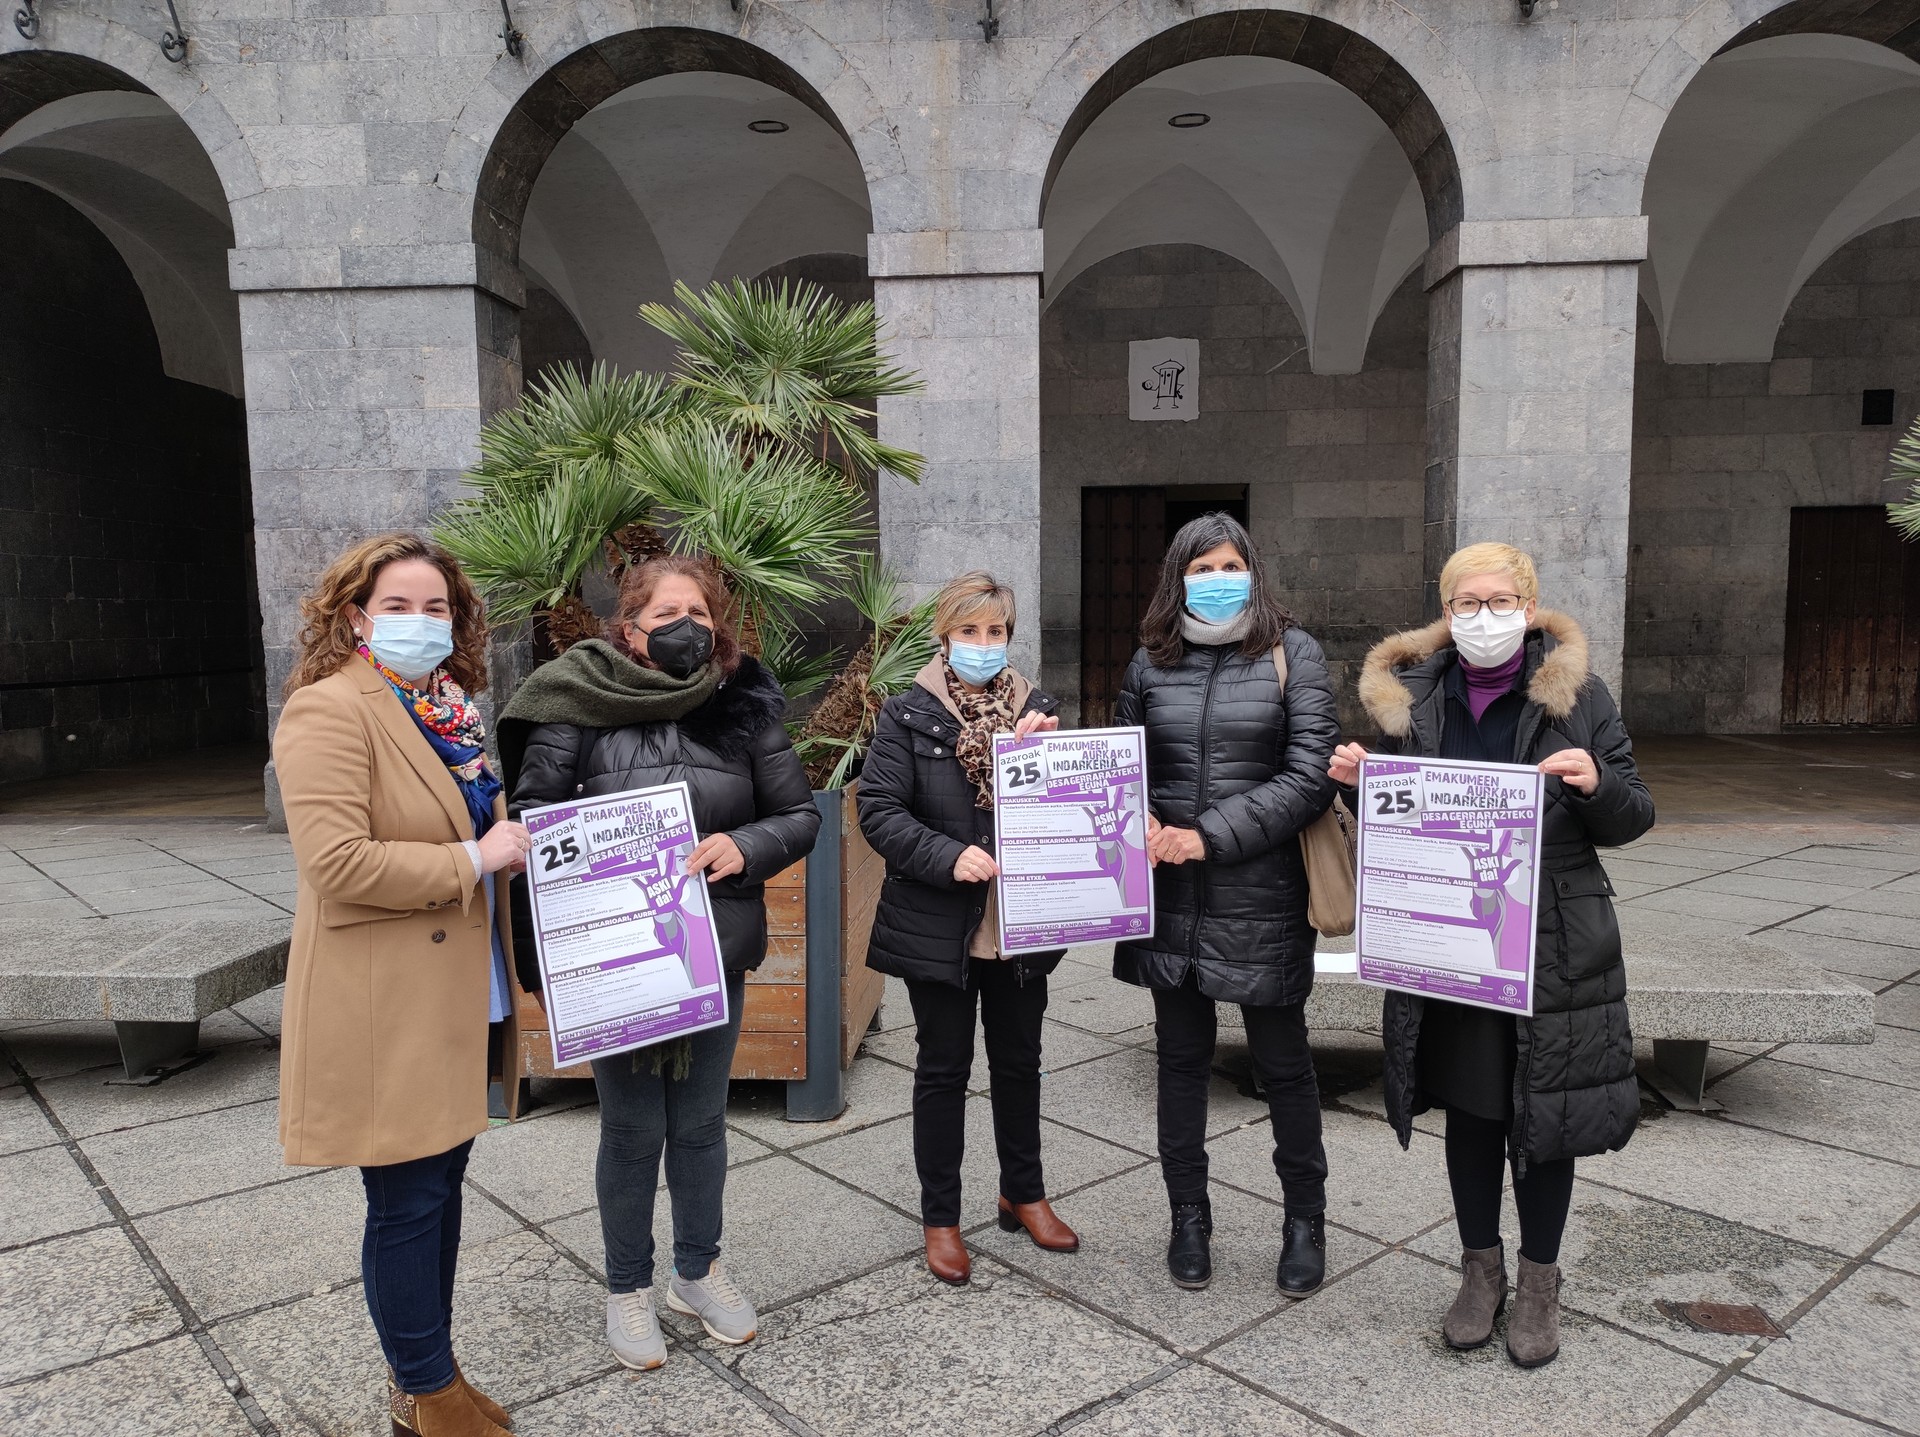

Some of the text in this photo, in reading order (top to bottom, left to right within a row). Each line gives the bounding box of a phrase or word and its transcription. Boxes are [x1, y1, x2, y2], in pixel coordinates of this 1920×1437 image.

[1047, 739, 1108, 752] EMAKUMEEN
[1082, 748, 1131, 759] AURKAKO
[1000, 749, 1040, 765] azaroak
[1053, 758, 1117, 771] INDARKERIA
[1005, 761, 1040, 788] 25
[1047, 766, 1139, 788] DESAGERRARAZTEKO
[1367, 777, 1416, 788] azaroak
[1424, 771, 1499, 787] EMAKUMEEN
[1079, 779, 1109, 790] EGUNA
[1466, 785, 1526, 800] AURKAKO
[1372, 790, 1415, 814] 25
[1430, 792, 1508, 808] INDARKERIA
[583, 800, 652, 823] EMAKUMEEN
[623, 806, 678, 826] AURKAKO
[1094, 810, 1116, 826] ASKI
[1422, 810, 1534, 821] DESAGERRARAZTEKO
[592, 819, 665, 844] INDARKERIA
[1100, 822, 1117, 835] da!
[1365, 825, 1411, 834] ERAKUSKETA
[1459, 819, 1495, 828] EGUNA
[532, 821, 577, 846] azaroak
[588, 824, 689, 863] DESAGERRARAZTEKO
[539, 835, 581, 872] 25
[625, 843, 658, 861] EGUNA
[1473, 856, 1499, 869] ASKI
[1364, 868, 1478, 887] BIOLENTZIA BIKARIOARI, AURRE
[1479, 869, 1498, 881] da!
[536, 877, 582, 891] ERAKUSKETA
[646, 877, 671, 899] ASKI
[655, 889, 673, 908] da!
[1363, 906, 1411, 918] MALEN ETXEA
[543, 909, 656, 939] BIOLENTZIA BIKARIOARI, AURRE
[1007, 923, 1059, 932] SENTSIBILIZAZIO
[550, 965, 601, 982] MALEN ETXEA
[1363, 958, 1459, 979] SENTSIBILIZAZIO KANPAINA
[560, 1020, 621, 1040] SENTSIBILIZAZIO
[622, 1010, 659, 1024] KANPAINA
